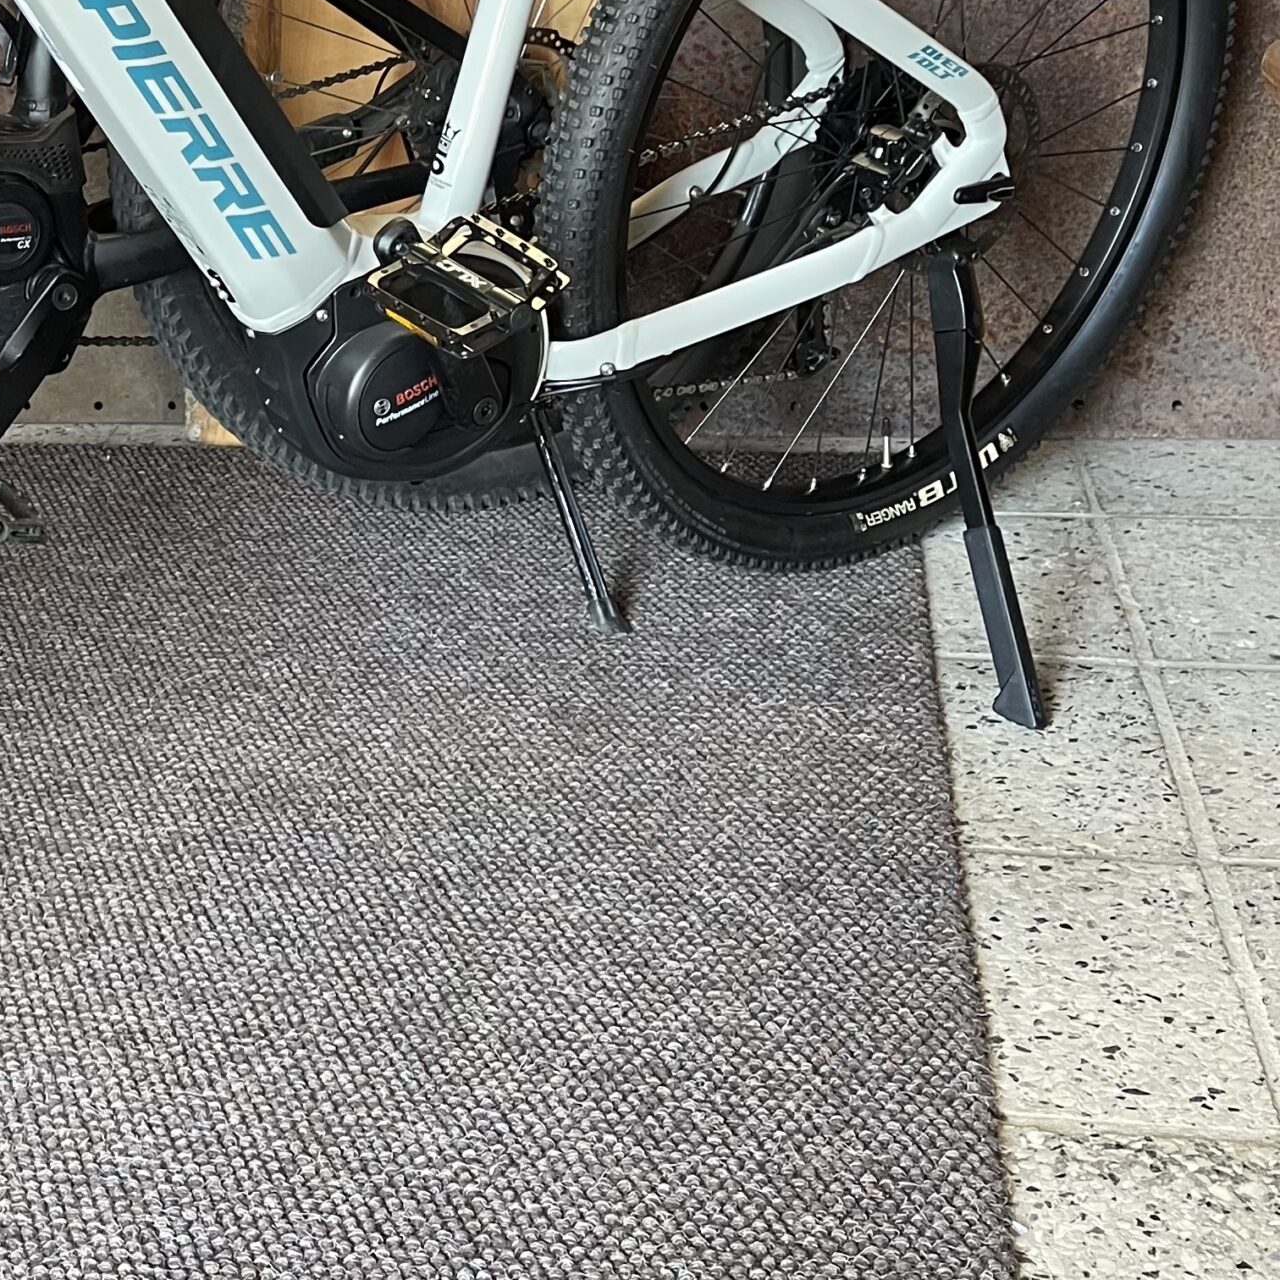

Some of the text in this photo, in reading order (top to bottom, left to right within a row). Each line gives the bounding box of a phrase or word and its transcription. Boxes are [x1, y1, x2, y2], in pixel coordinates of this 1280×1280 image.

[0, 223, 33, 235] BOSCH
[17, 239, 31, 250] CX
[395, 374, 438, 406] BOSCH
[864, 497, 917, 527] RANGER
